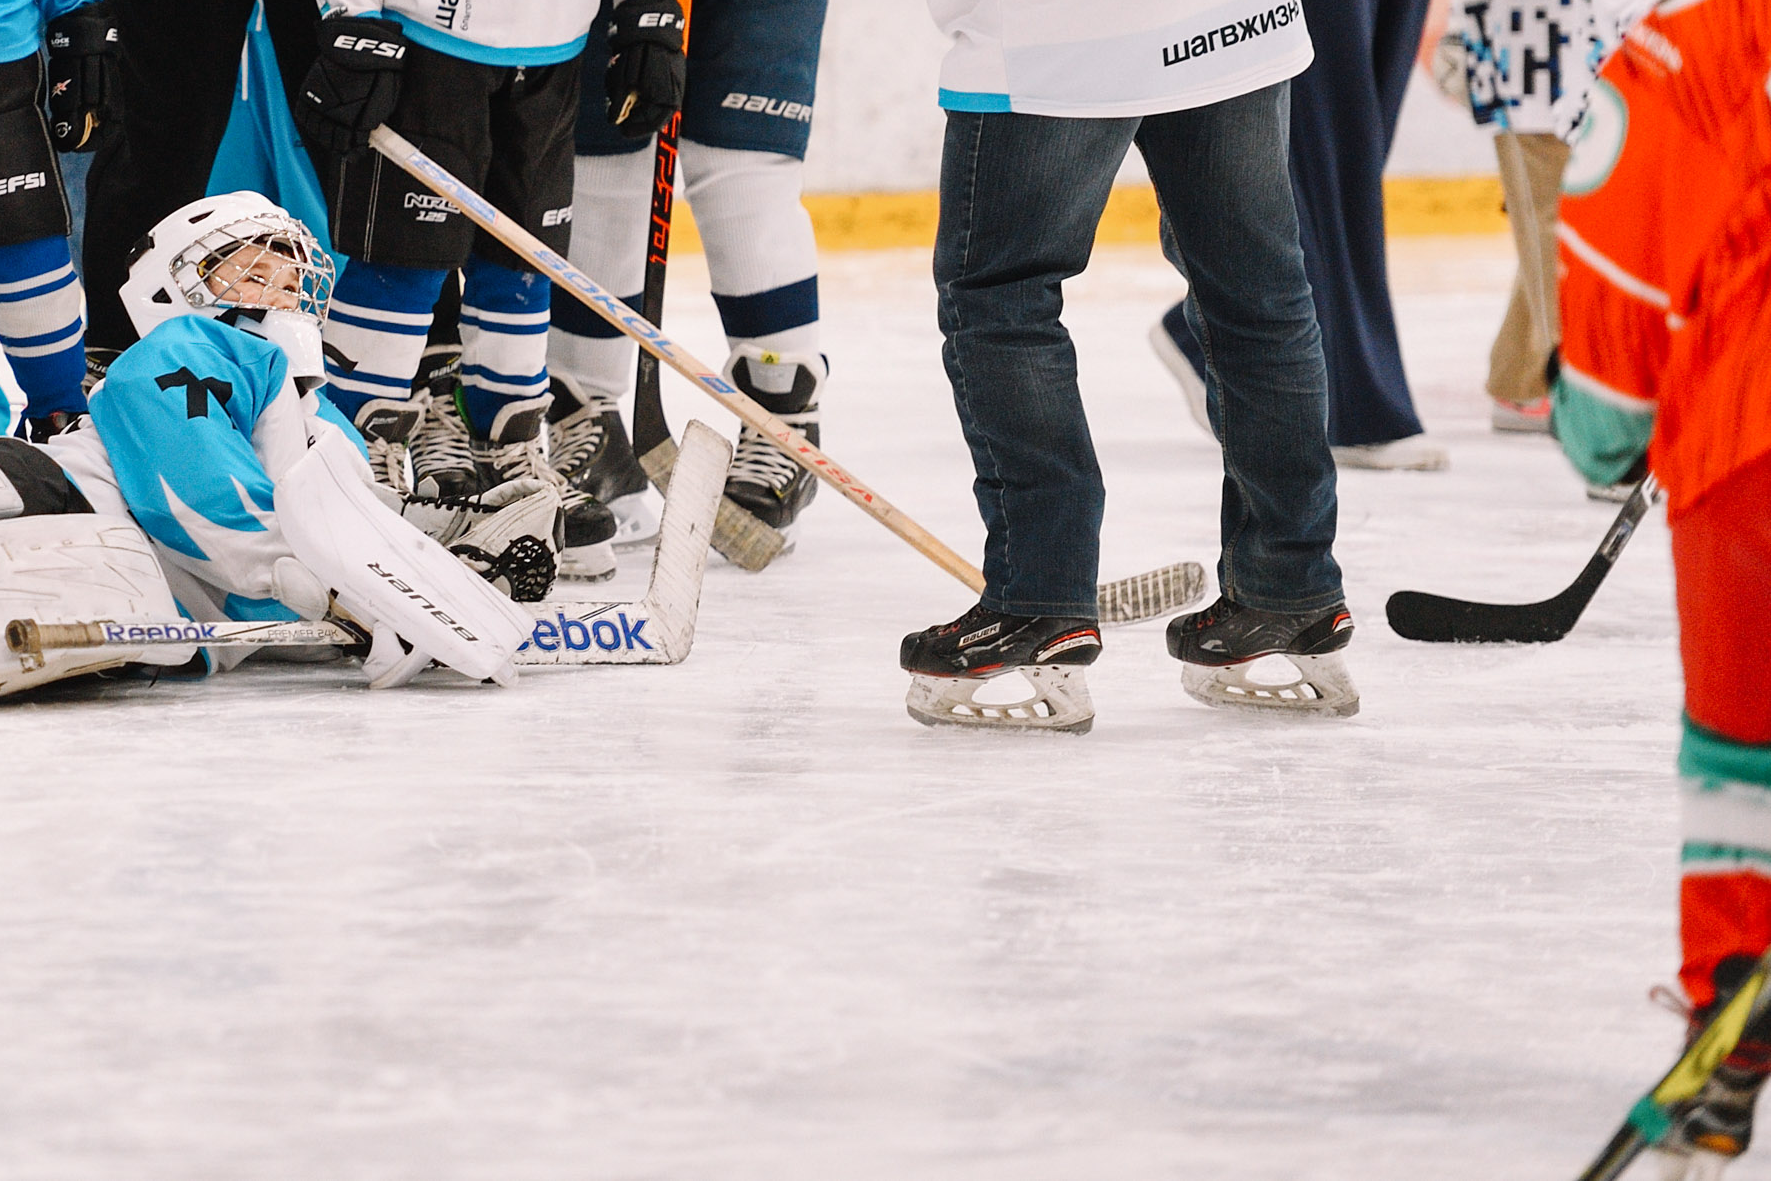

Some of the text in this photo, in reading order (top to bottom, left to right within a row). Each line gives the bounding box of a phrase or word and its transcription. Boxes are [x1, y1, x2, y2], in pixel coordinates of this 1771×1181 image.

[333, 34, 406, 60] EFSI
[415, 210, 448, 223] 125
[534, 249, 675, 359] SOKOL
[105, 623, 219, 643] Reebok
[267, 629, 315, 640] PREMIER
[517, 611, 656, 651] ebok
